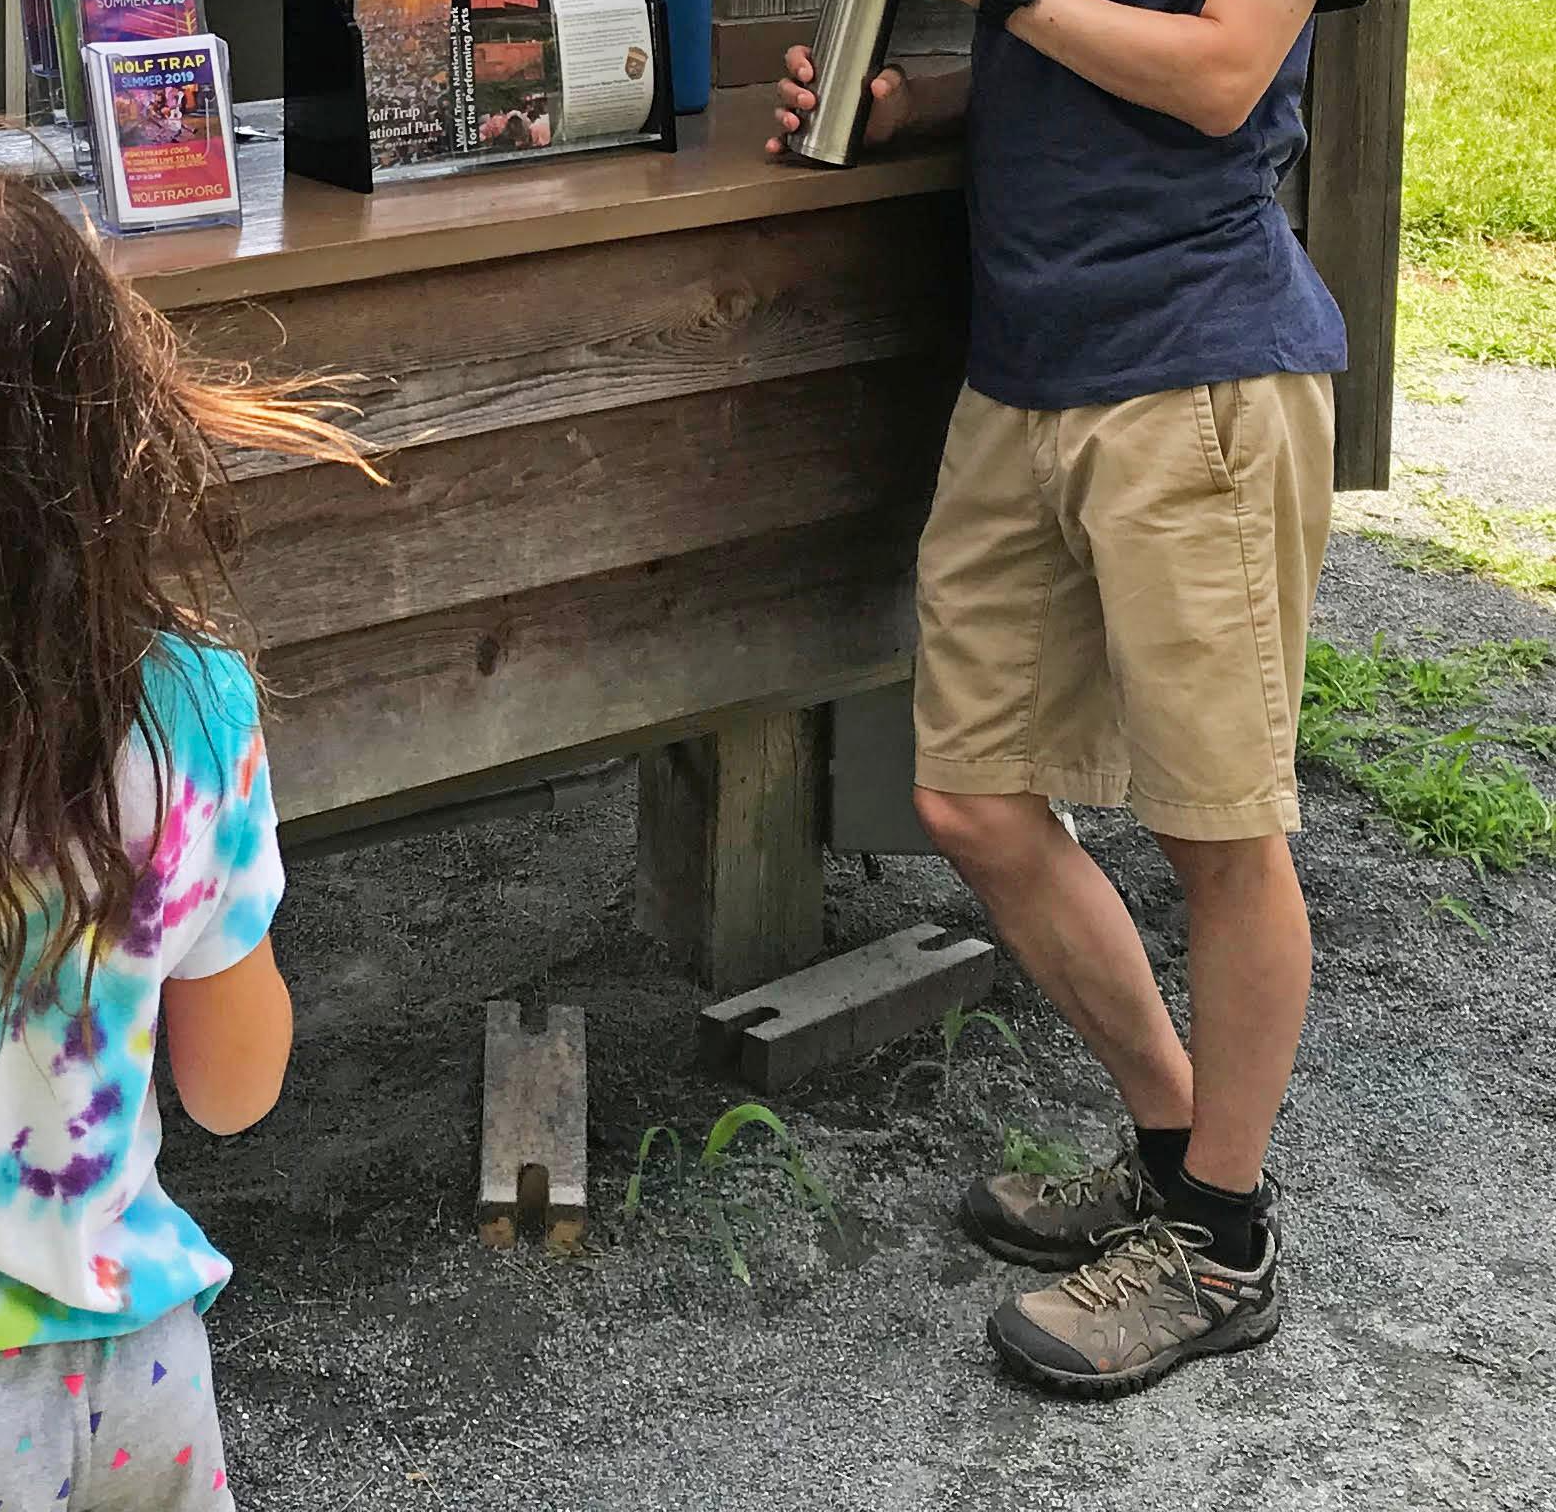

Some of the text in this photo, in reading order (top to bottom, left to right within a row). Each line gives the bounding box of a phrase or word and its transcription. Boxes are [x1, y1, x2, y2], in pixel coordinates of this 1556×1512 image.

[113, 54, 206, 75] WOLF TRAP
[450, 36, 461, 87] National
[121, 71, 195, 88] SUMMER 2019
[461, 7, 478, 146] for the Performing Arts
[391, 106, 421, 121] Trap
[369, 118, 443, 140] ational Park
[131, 183, 224, 204] WOLFTRAP.ORG
